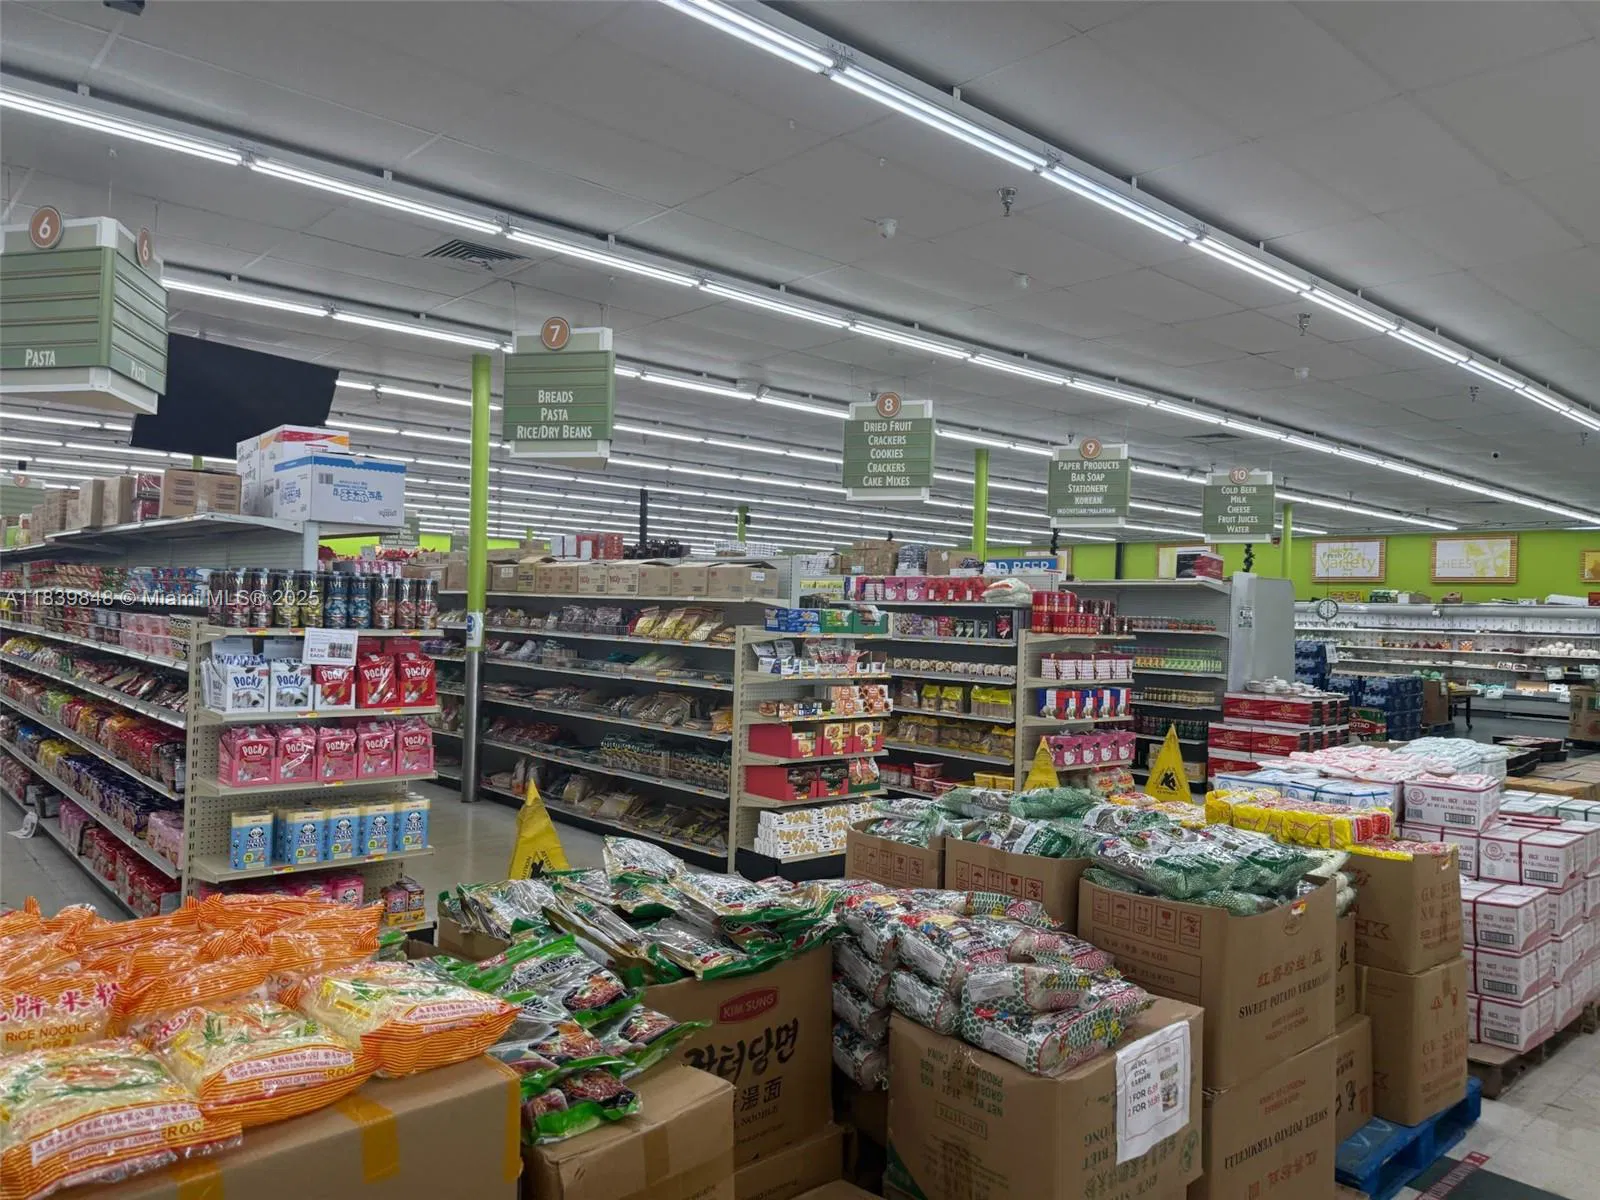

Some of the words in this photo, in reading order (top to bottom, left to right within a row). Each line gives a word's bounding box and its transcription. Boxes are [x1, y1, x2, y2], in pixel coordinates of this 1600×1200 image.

[38, 215, 51, 239] 6
[142, 239, 150, 259] 6
[549, 325, 561, 343] 7
[25, 348, 56, 368] PASTA
[538, 390, 574, 403] BREADS
[884, 398, 893, 412] 8
[540, 407, 569, 421] PASTA
[562, 425, 593, 439] BEANS
[863, 421, 887, 432] DRIED
[889, 420, 912, 431] FRUIT
[868, 435, 907, 446] CRACKERS
[870, 448, 904, 459] COOKIES
[1086, 442, 1095, 455] 9
[867, 462, 906, 473] CRACKERS
[1058, 461, 1080, 471] PAPER
[1083, 461, 1120, 470] PRODUCTS
[863, 476, 883, 486] CAKE
[886, 476, 910, 486] MIXES
[1071, 473, 1085, 481] BAR
[1087, 472, 1105, 481] SOAP
[1233, 470, 1246, 480] 10
[1068, 484, 1108, 493] STATIONERY
[1221, 486, 1238, 494] COLD
[1240, 486, 1257, 494] BEER
[1230, 496, 1247, 504] MILK
[1227, 505, 1251, 513] CHEESE
[1227, 525, 1250, 533] WATER
[233, 674, 263, 689] POCKY
[276, 673, 305, 687] POCKY
[745, 994, 775, 1011] SUNG
[1132, 1088, 1146, 1101] FOR
[1132, 1101, 1146, 1115] FOR
